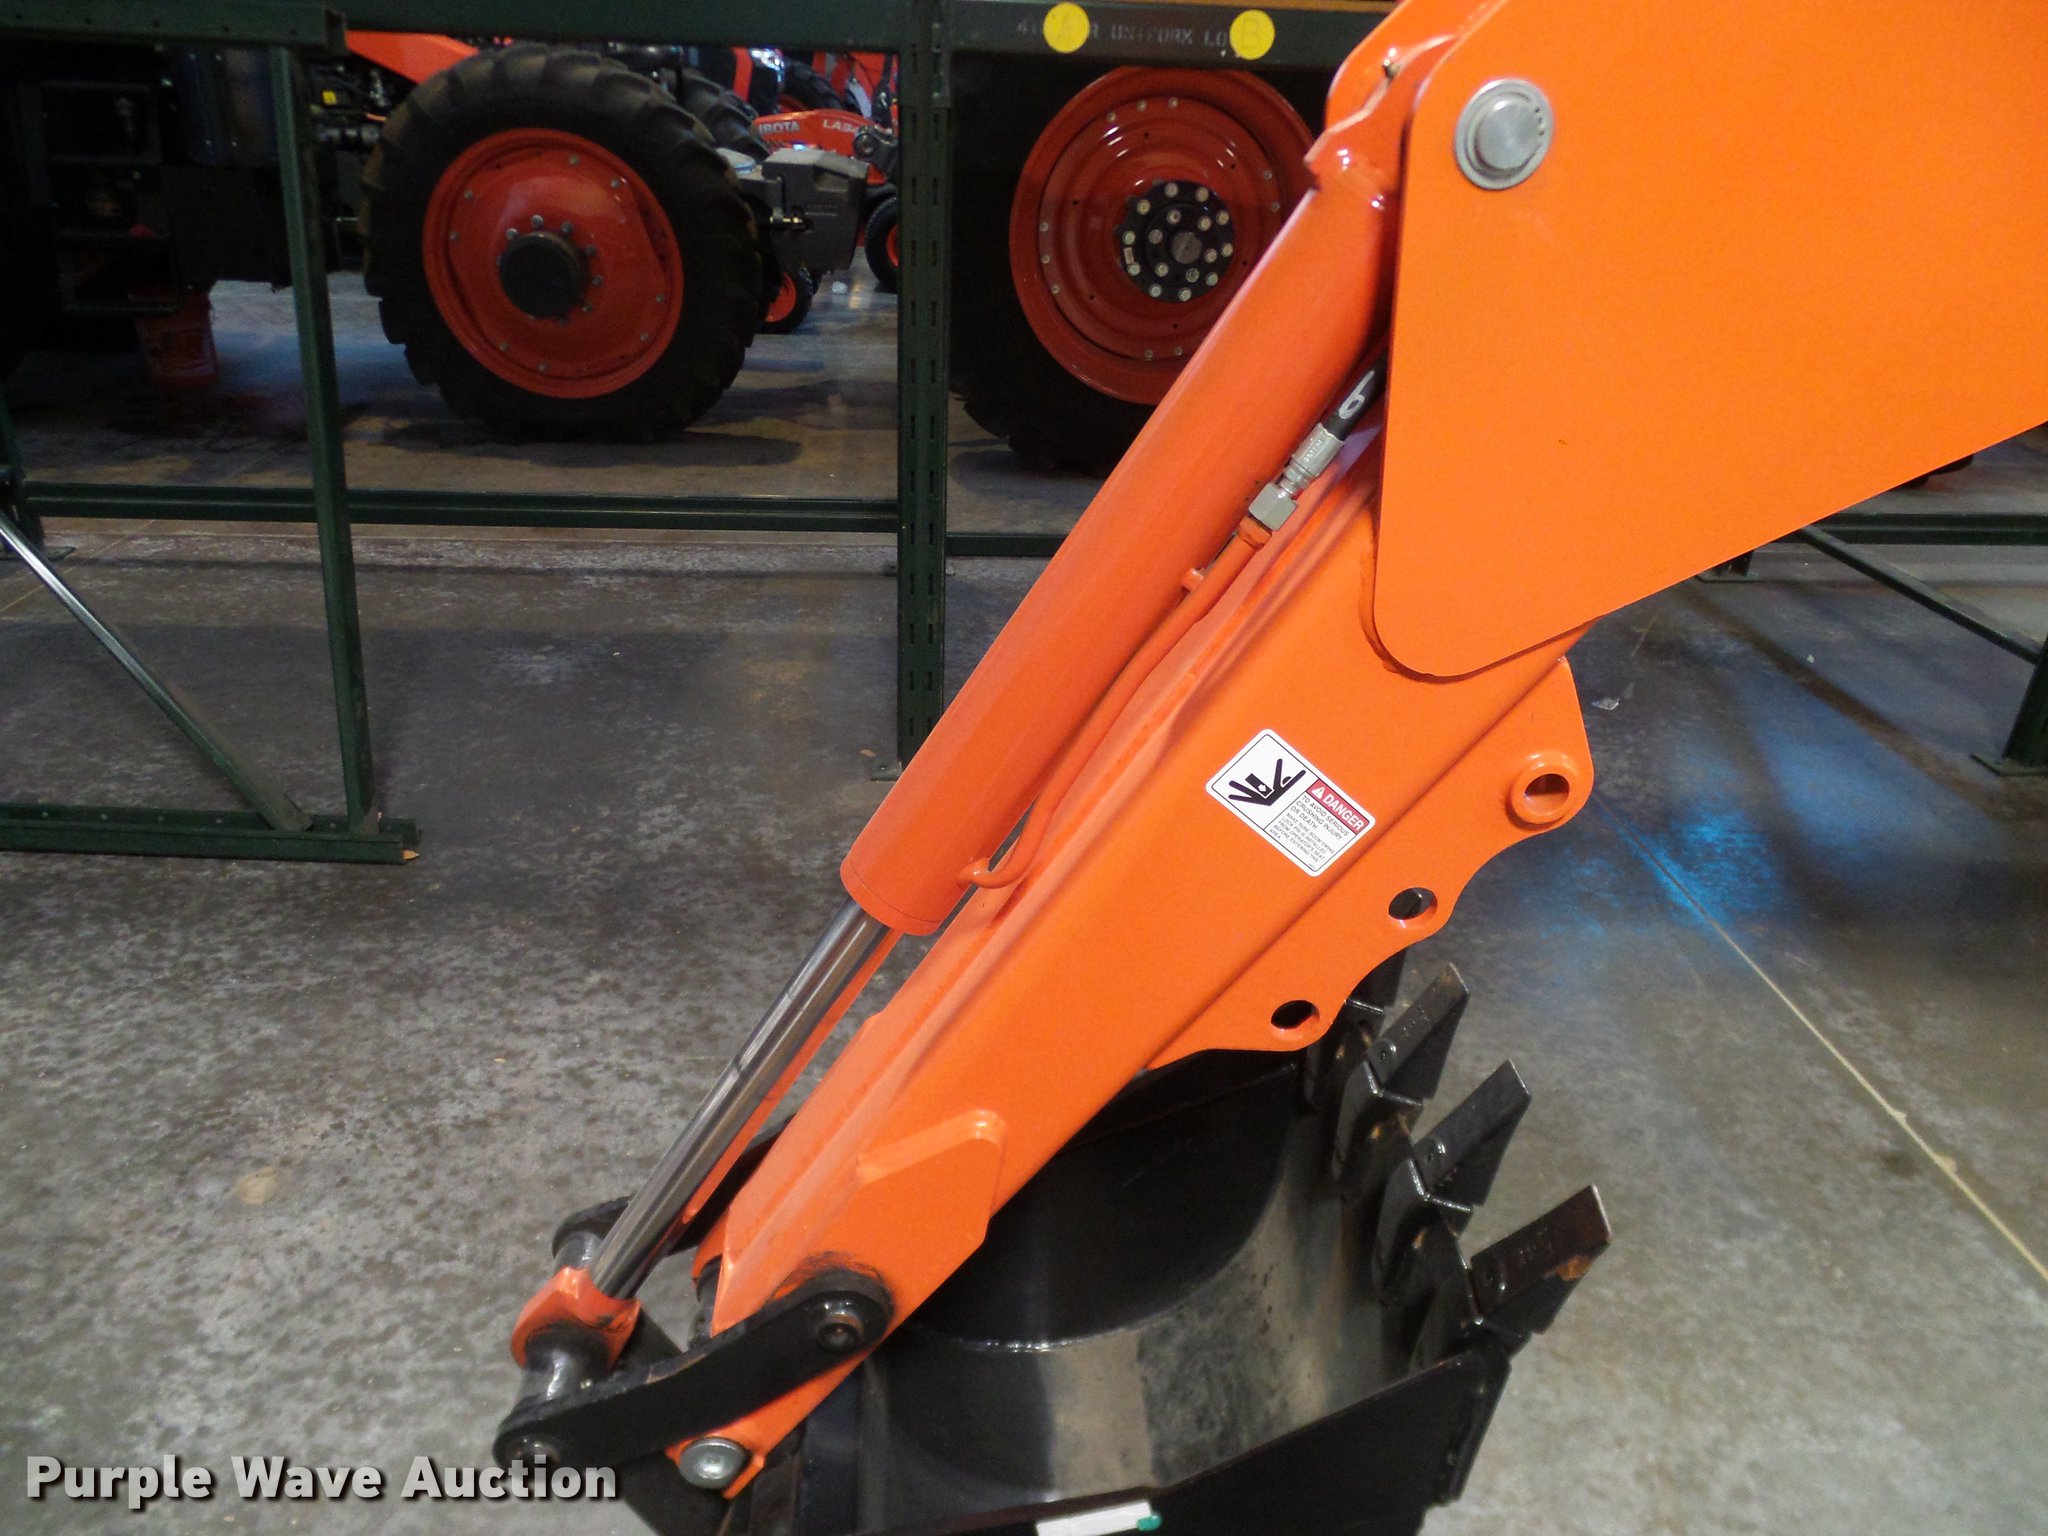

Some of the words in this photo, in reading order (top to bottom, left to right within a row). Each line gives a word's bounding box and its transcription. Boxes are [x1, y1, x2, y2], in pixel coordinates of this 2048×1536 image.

[1338, 369, 1376, 420] 6
[1290, 805, 1300, 814] OR
[1295, 800, 1324, 824] CRUSHING
[1322, 823, 1342, 840] INJURY
[1301, 795, 1310, 803] TO
[1309, 802, 1326, 817] AVOID
[1325, 815, 1349, 836] SERIOUS
[1322, 793, 1365, 831] DANGER
[1273, 824, 1290, 839] BEFORE
[1289, 837, 1310, 855] ENTERING
[1309, 853, 1319, 862] THIS
[1277, 820, 1290, 831] FROM
[1313, 850, 1324, 860] SEAT
[1281, 816, 1293, 827] LOCK
[1304, 836, 1326, 854] INSTALLED
[1286, 813, 1298, 823] MAKE
[1297, 822, 1309, 833] SURE
[1308, 831, 1322, 843] BOOM
[1321, 841, 1334, 853] SWING
